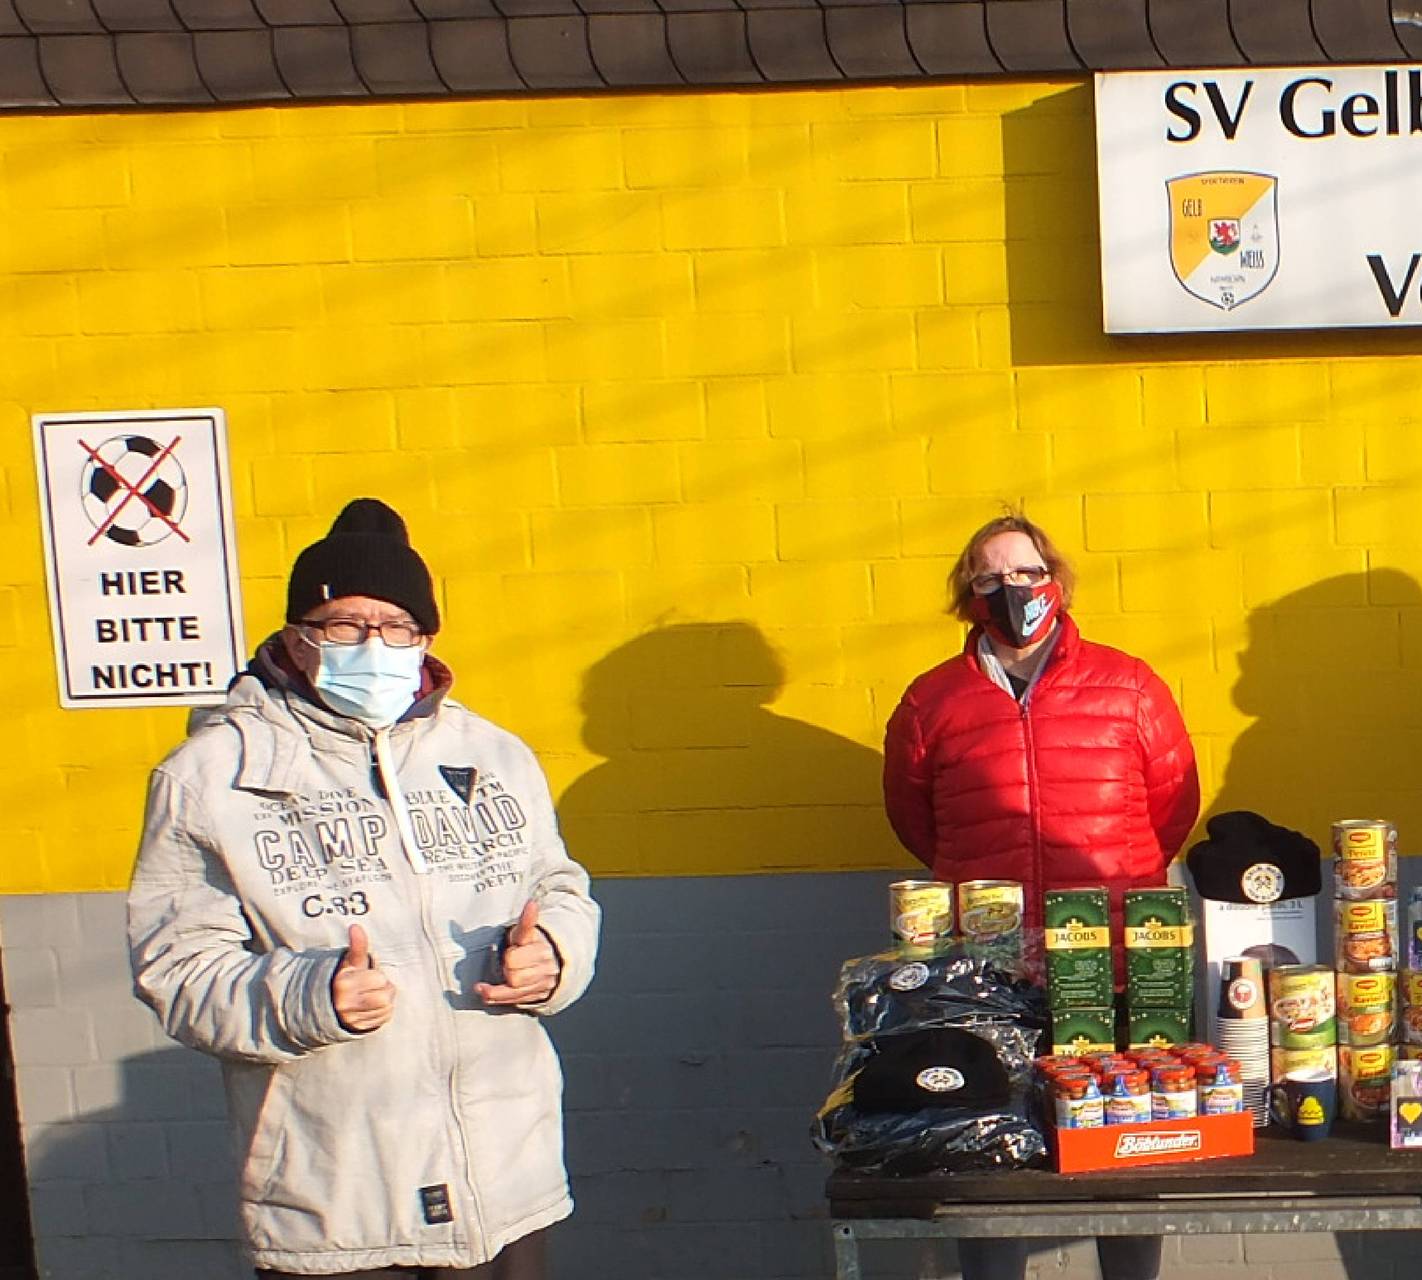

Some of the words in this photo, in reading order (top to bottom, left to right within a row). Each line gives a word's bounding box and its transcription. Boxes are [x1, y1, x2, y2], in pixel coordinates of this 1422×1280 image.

[1165, 79, 1254, 142] SV
[101, 570, 186, 596] HIER
[97, 616, 200, 643] BITTE
[92, 662, 213, 689] NICHT!
[408, 794, 527, 850] DAVID
[254, 814, 387, 871] CAMP
[1055, 930, 1098, 943] JACOBS
[1133, 930, 1177, 941] JACOBS
